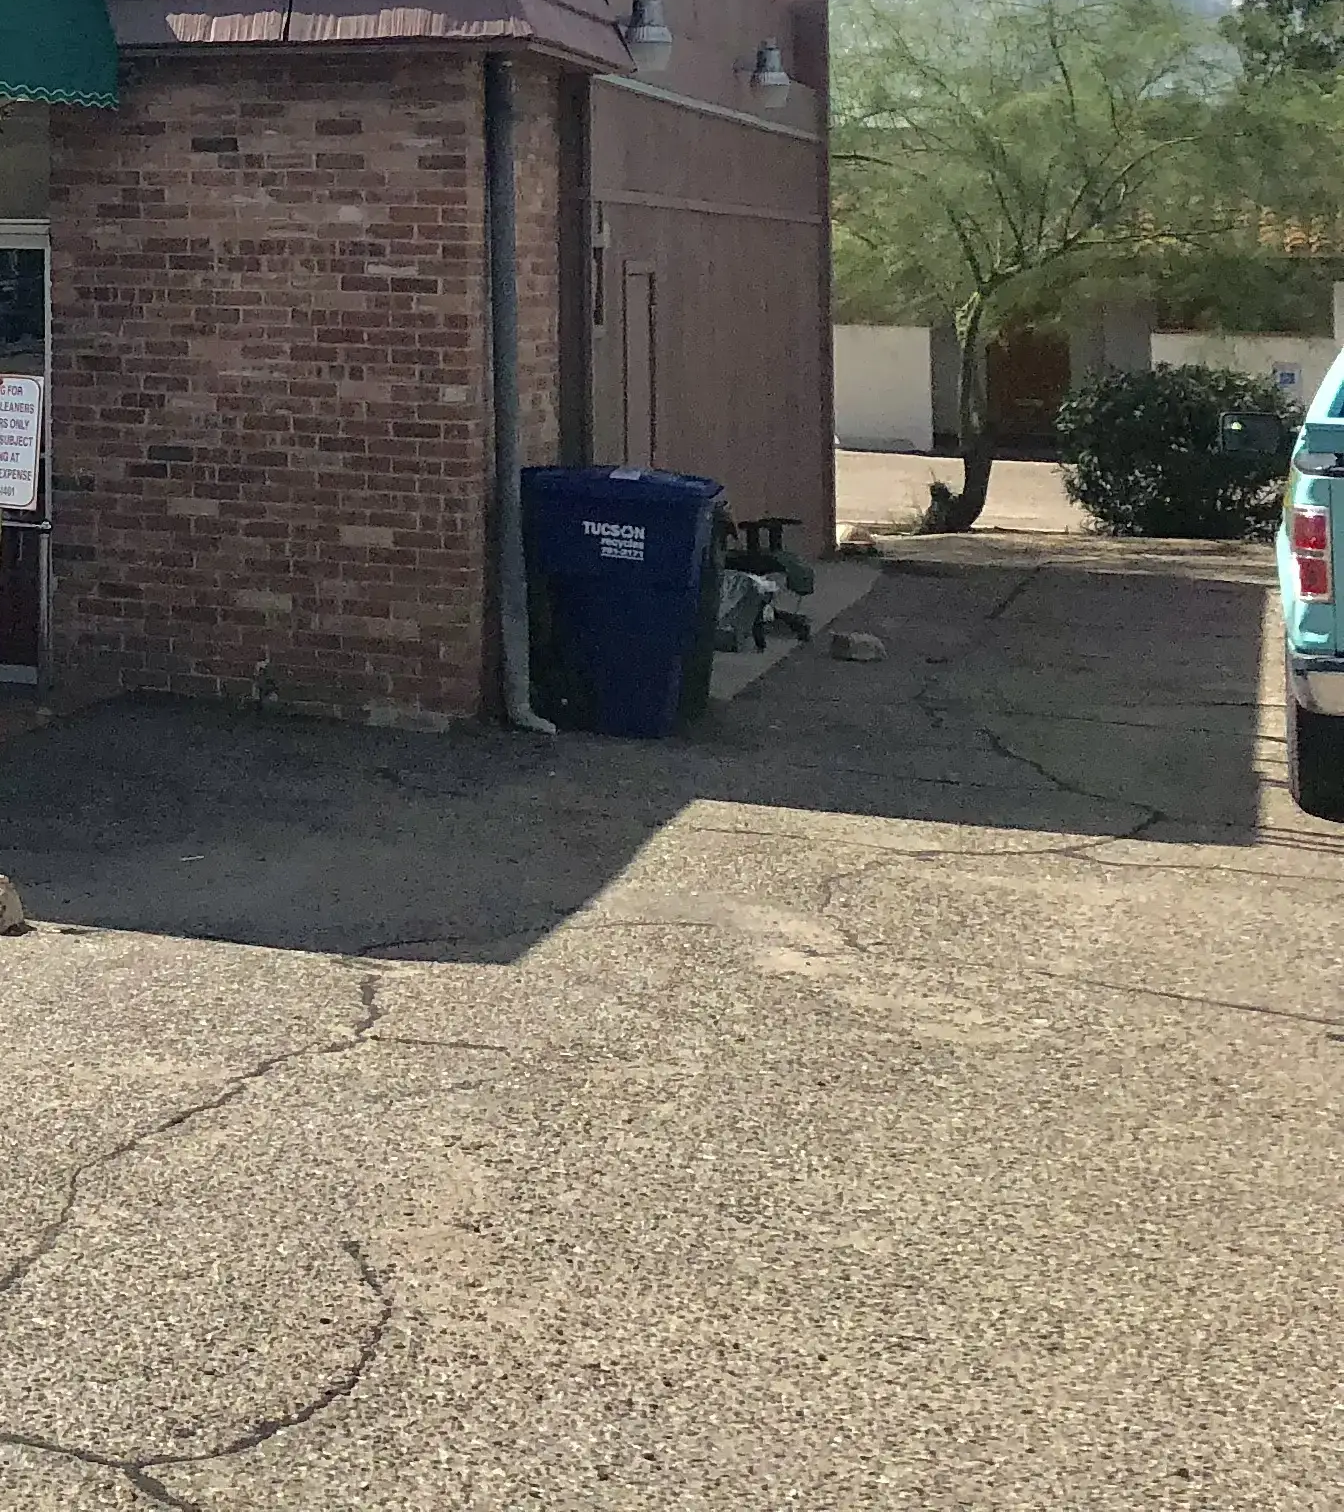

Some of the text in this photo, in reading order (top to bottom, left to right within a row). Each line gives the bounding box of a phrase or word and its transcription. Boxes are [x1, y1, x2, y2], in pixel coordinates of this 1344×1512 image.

[7, 385, 23, 396] FOR
[9, 419, 30, 430] ONLY
[0, 435, 34, 447] SUBJECT
[9, 452, 20, 463] AT
[582, 520, 645, 539] TUCSON
